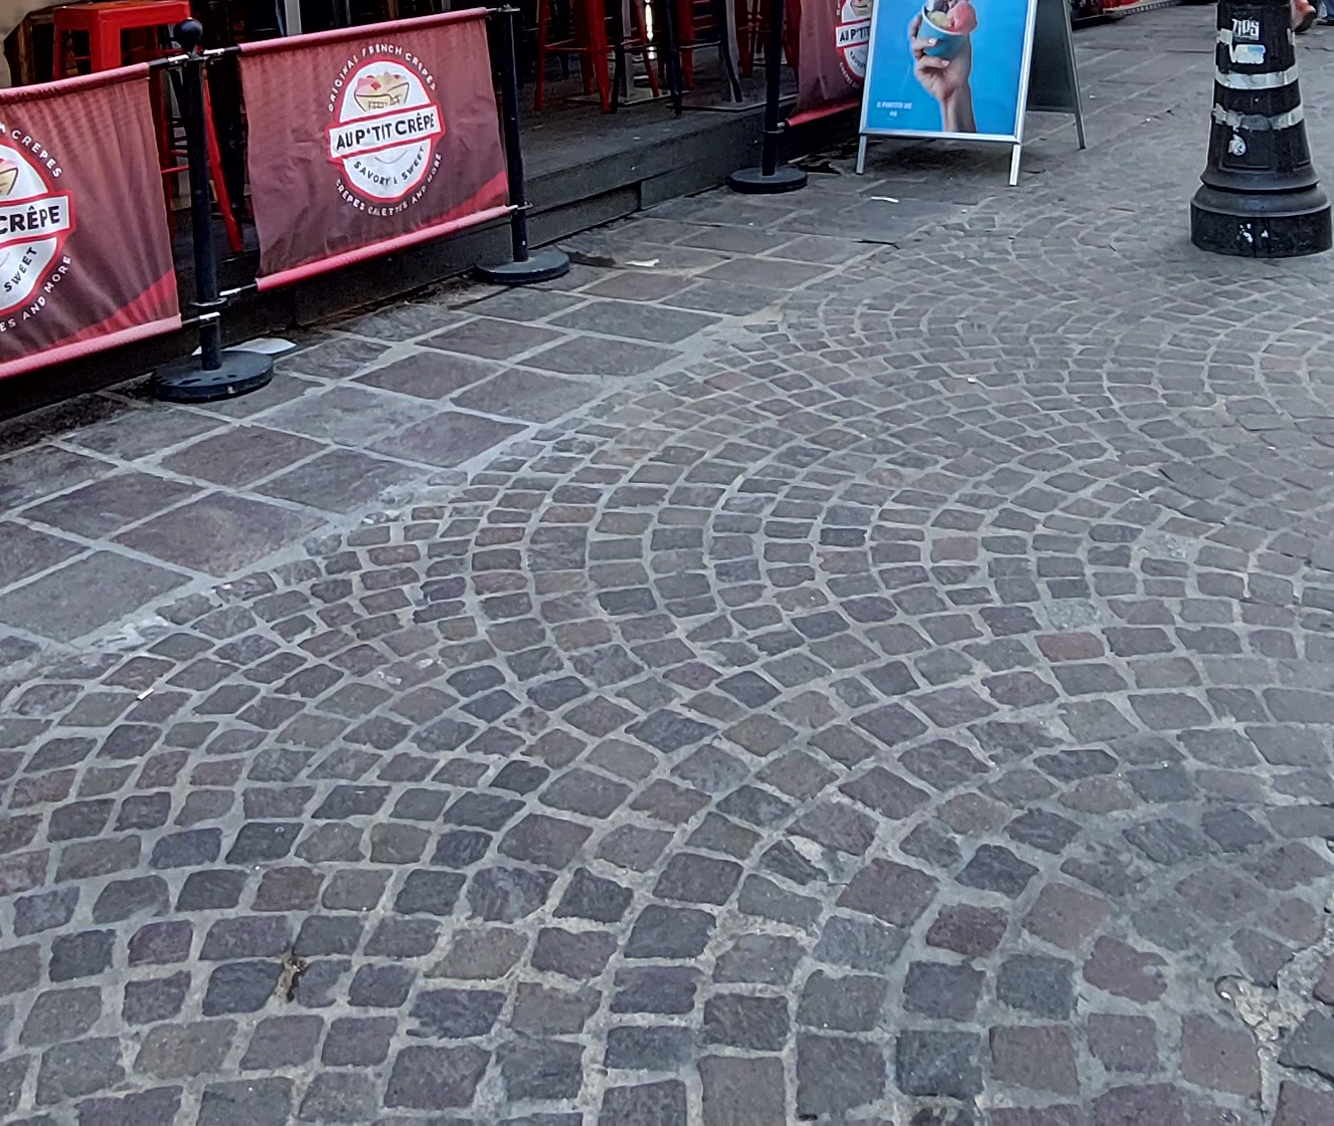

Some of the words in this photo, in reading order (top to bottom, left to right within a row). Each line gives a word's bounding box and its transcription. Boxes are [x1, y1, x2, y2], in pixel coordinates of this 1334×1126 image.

[361, 43, 403, 57] FRENCH
[336, 133, 354, 151] AU
[354, 124, 393, 146] P'TIT
[394, 112, 435, 135] CRÊPE
[11, 130, 63, 178] CREPES
[353, 159, 391, 186] SAVORY
[3, 247, 38, 293] SWEET
[22, 295, 46, 320] AND
[44, 255, 72, 294] MORE
